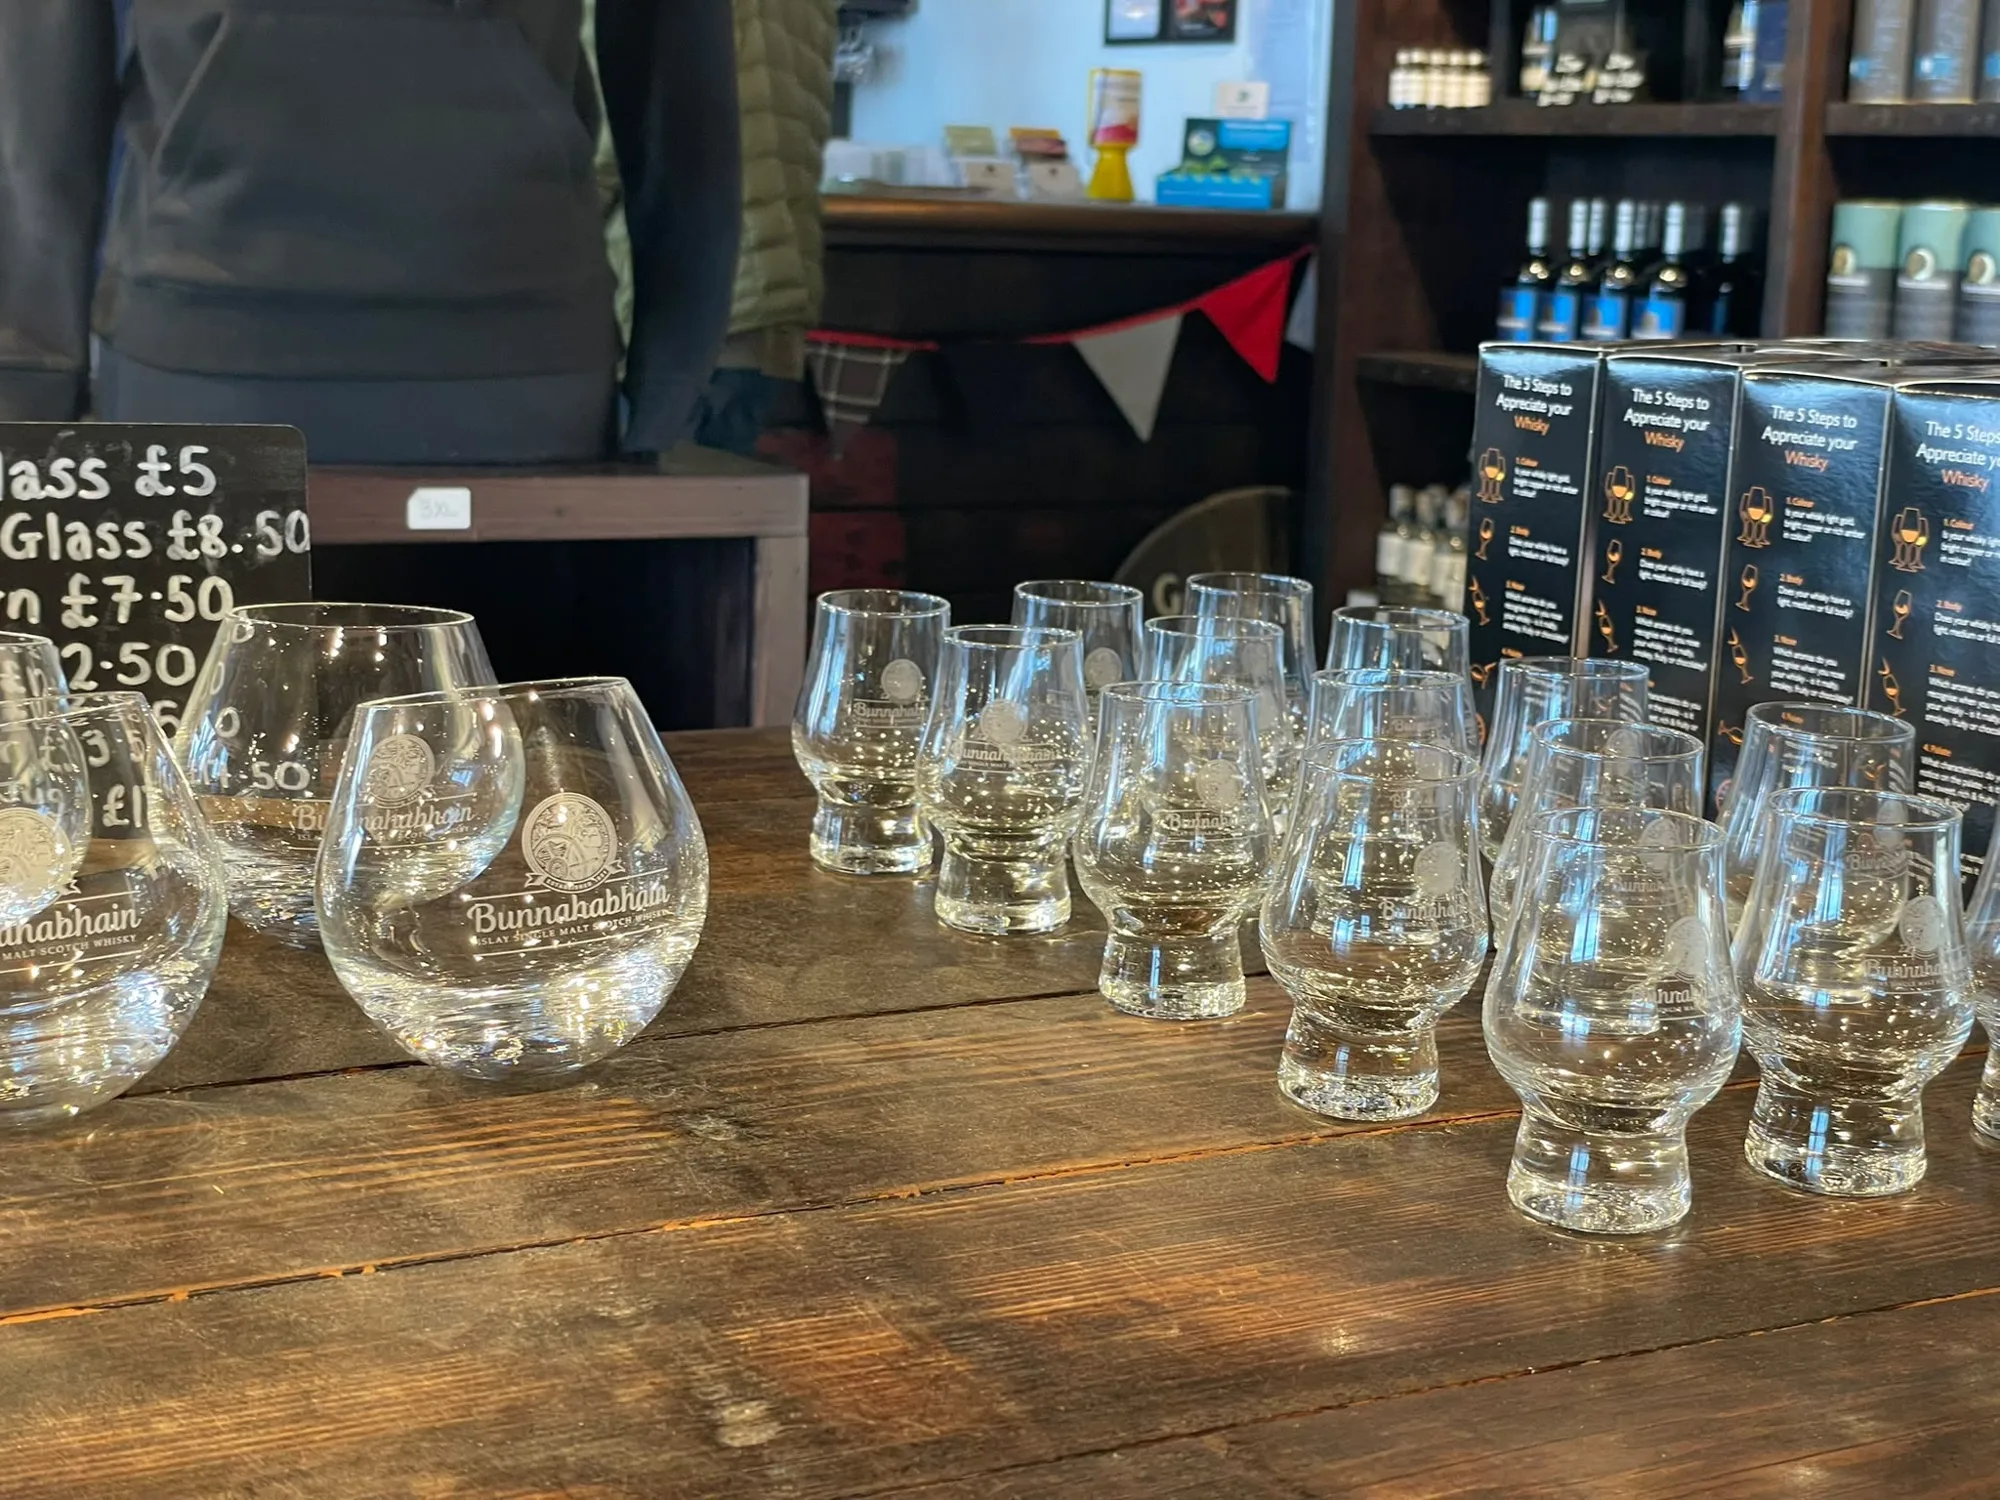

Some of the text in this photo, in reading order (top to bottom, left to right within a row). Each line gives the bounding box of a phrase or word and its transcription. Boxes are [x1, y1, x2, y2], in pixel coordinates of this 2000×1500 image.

[1503, 374, 1573, 398] The 5 Steps to
[1495, 394, 1573, 418] Appreciate your
[1632, 388, 1710, 412] The 5 Steps to
[1514, 415, 1550, 436] Whisky
[1624, 408, 1710, 433] Appreciate your
[1771, 405, 1858, 430] The 5 Steps to
[1644, 431, 1685, 453] Whisky
[1761, 425, 1858, 452] Appreciate your
[1926, 421, 1951, 439] The
[1953, 424, 1963, 440] 5
[1785, 450, 1829, 472] Whisky
[1916, 442, 1986, 466] Appreciate
[135, 445, 217, 497] £5
[1941, 469, 1989, 492] Whisky
[1, 509, 310, 561] Glass £8.50
[0, 588, 41, 624] n
[466, 882, 671, 934] Bunnahabhain
[593, 915, 633, 931] SOTCH
[93, 933, 137, 948] WHISKY
